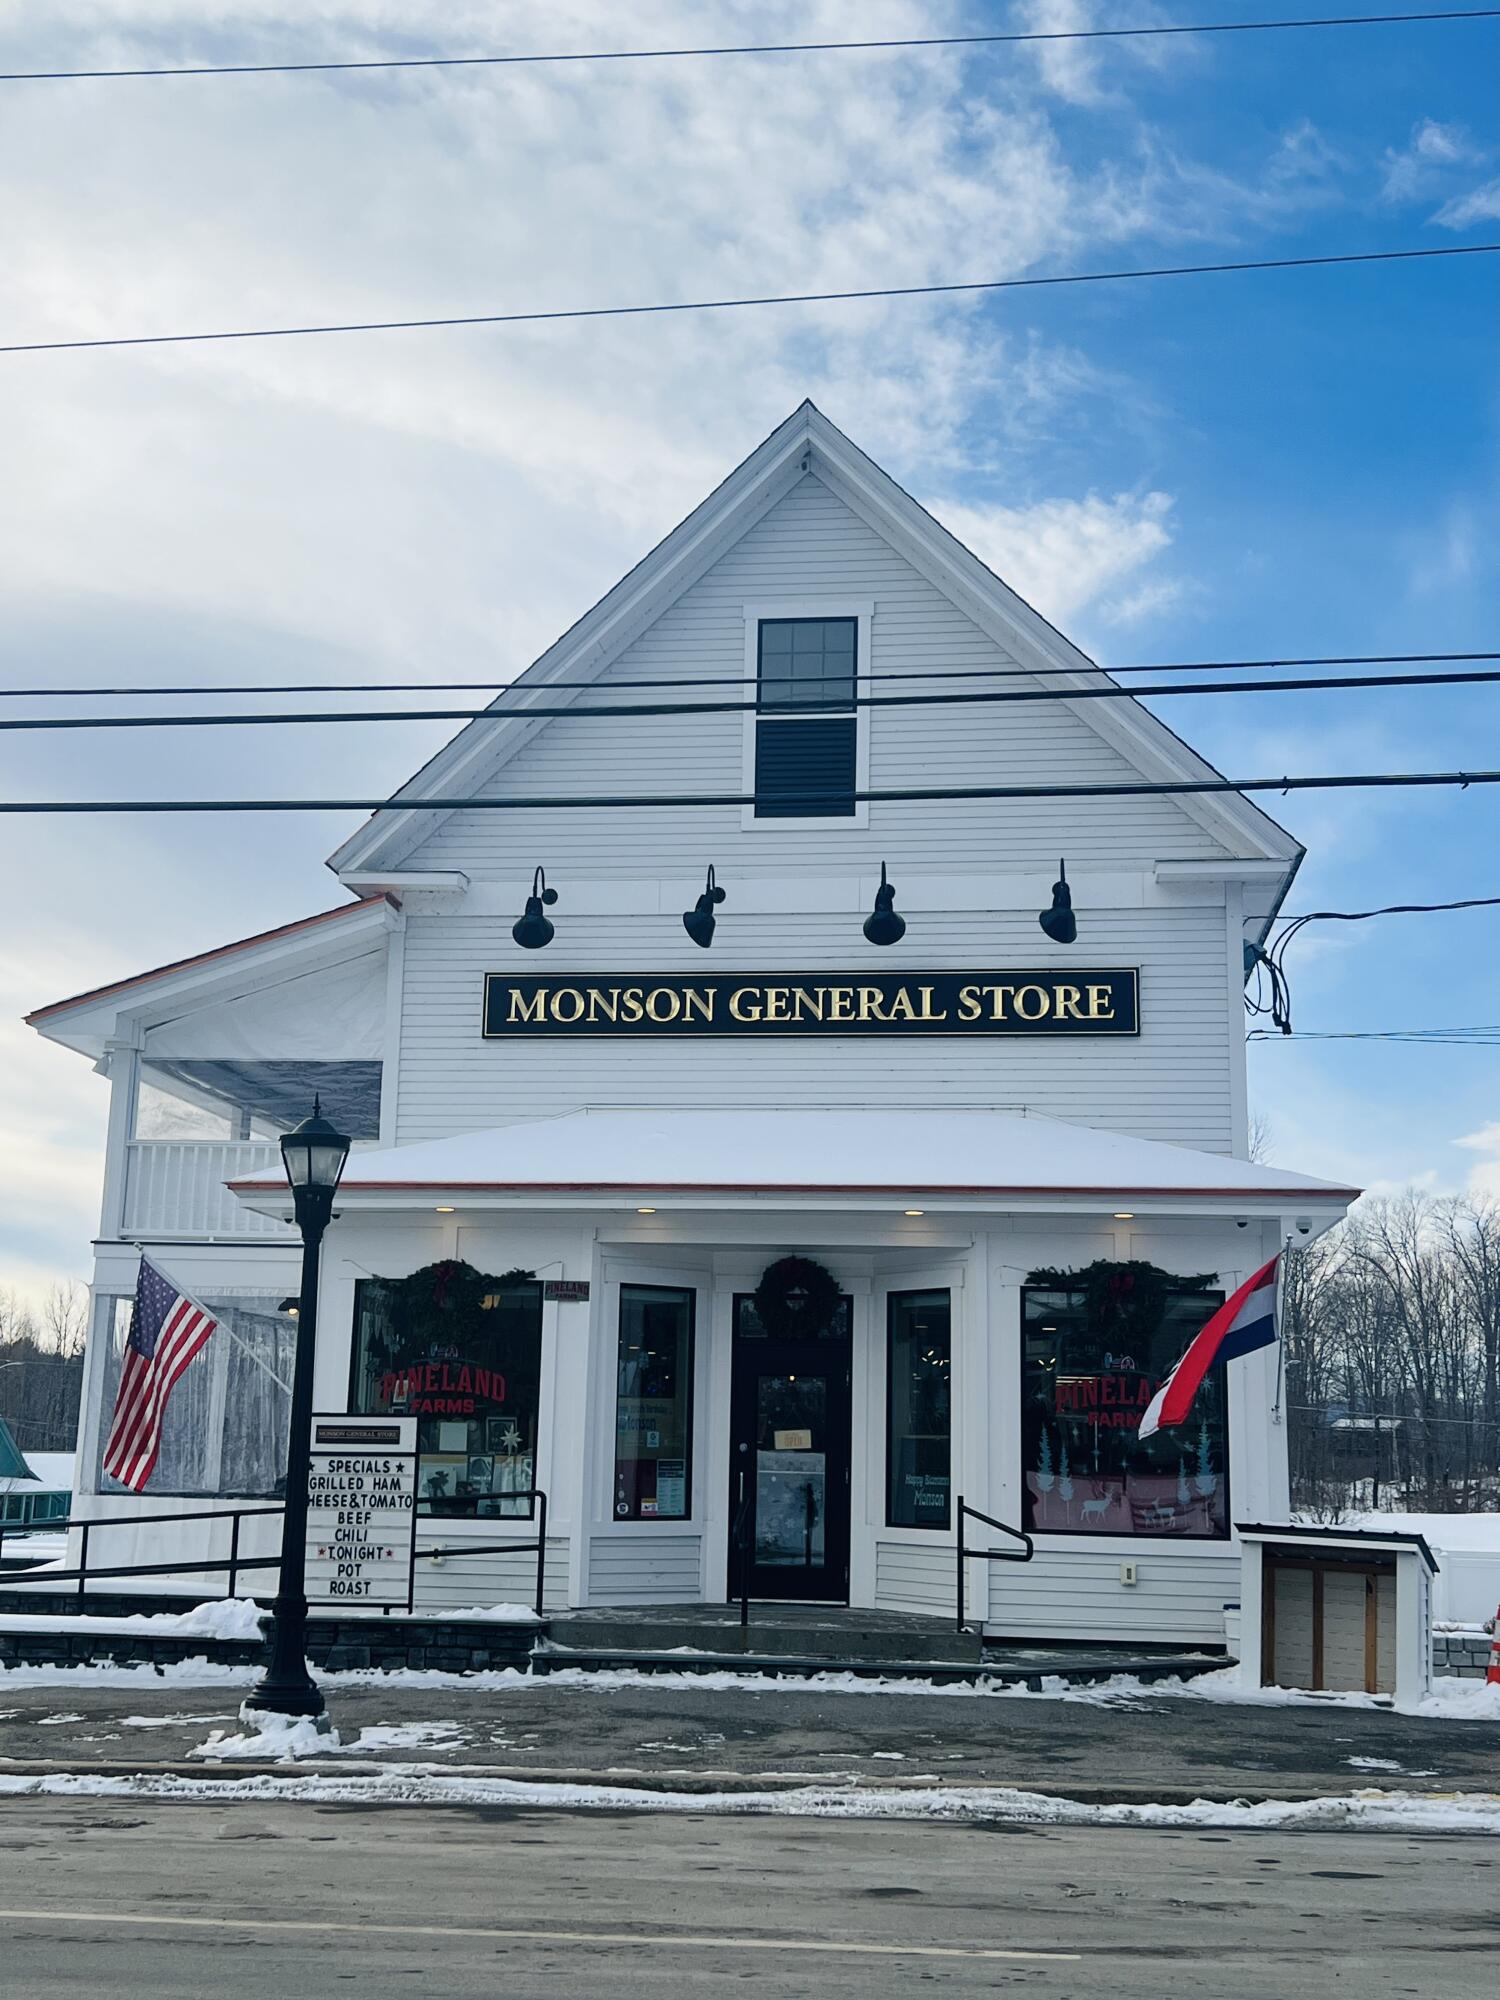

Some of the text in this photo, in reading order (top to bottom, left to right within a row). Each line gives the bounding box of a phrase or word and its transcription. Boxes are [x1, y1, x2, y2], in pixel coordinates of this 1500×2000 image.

[506, 984, 1116, 1023] MONSON GENERAL STORE
[545, 1281, 590, 1296] PINELAND
[382, 1364, 507, 1403] PINELAND
[1055, 1376, 1162, 1413] PINELA
[410, 1398, 475, 1414] FARMS
[1087, 1411, 1143, 1427] FARM
[328, 1459, 390, 1473] SPECIALS
[309, 1477, 401, 1490] GRILLED HAM
[337, 1512, 371, 1525] BEEF
[335, 1529, 368, 1542] CHILI
[337, 1563, 362, 1577] POT
[329, 1581, 371, 1595] ROAST
